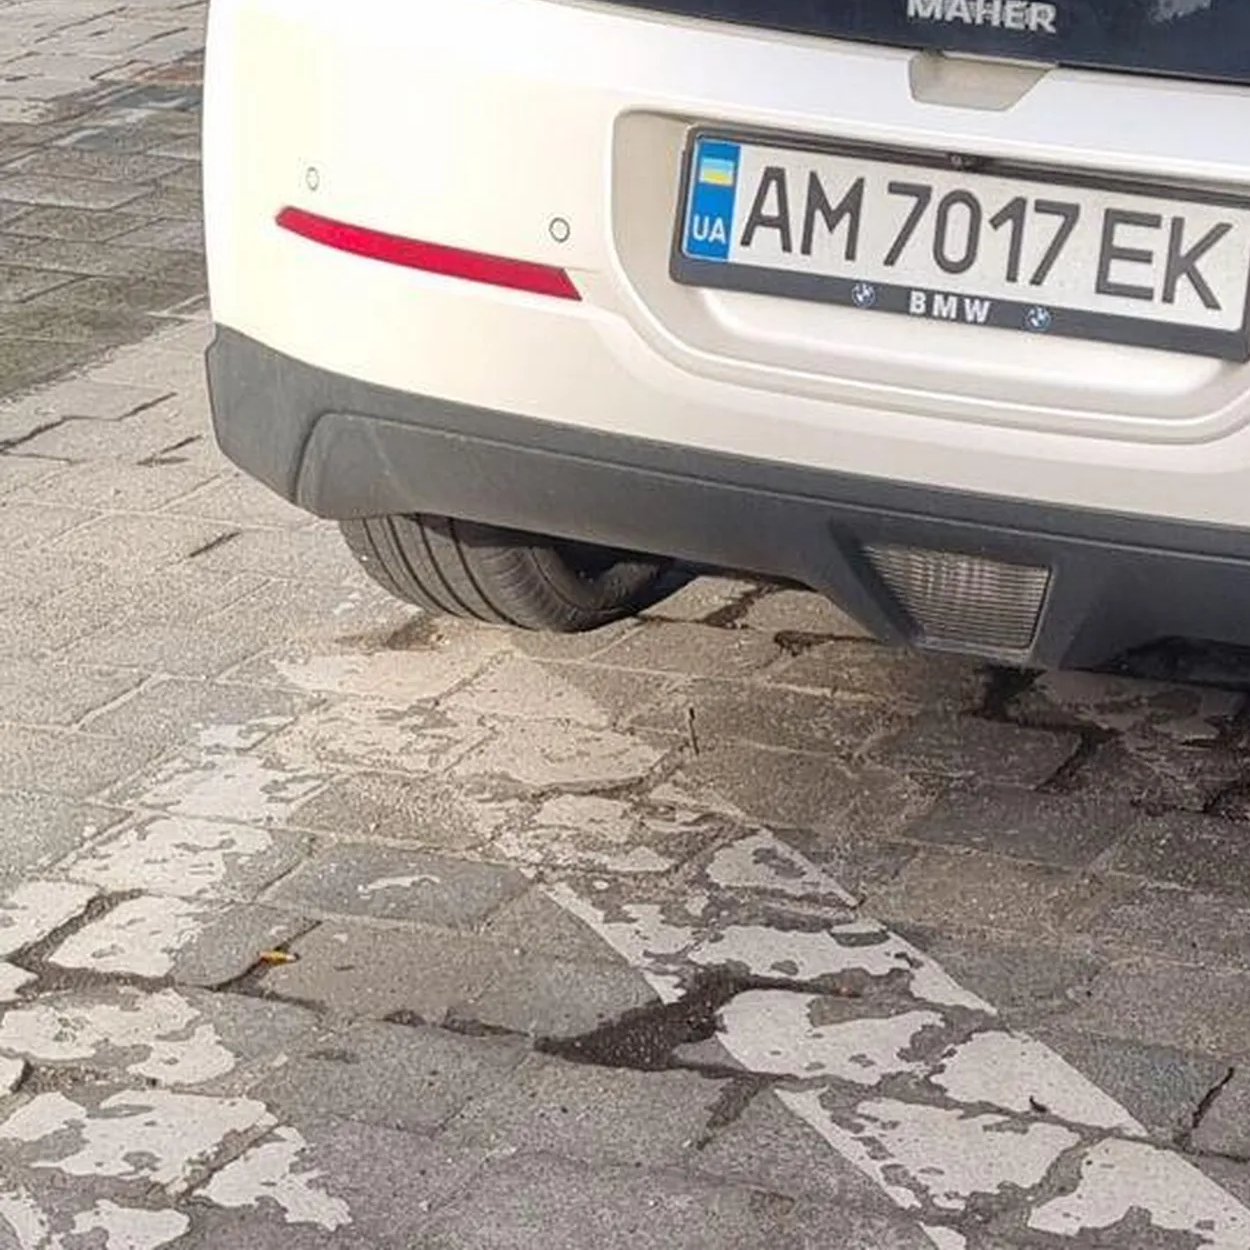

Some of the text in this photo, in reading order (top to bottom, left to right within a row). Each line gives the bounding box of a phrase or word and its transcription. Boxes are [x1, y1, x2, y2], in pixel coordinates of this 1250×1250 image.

[692, 214, 727, 245] UA
[740, 166, 1233, 311] AM 7017 EK
[909, 290, 990, 323] BMW
